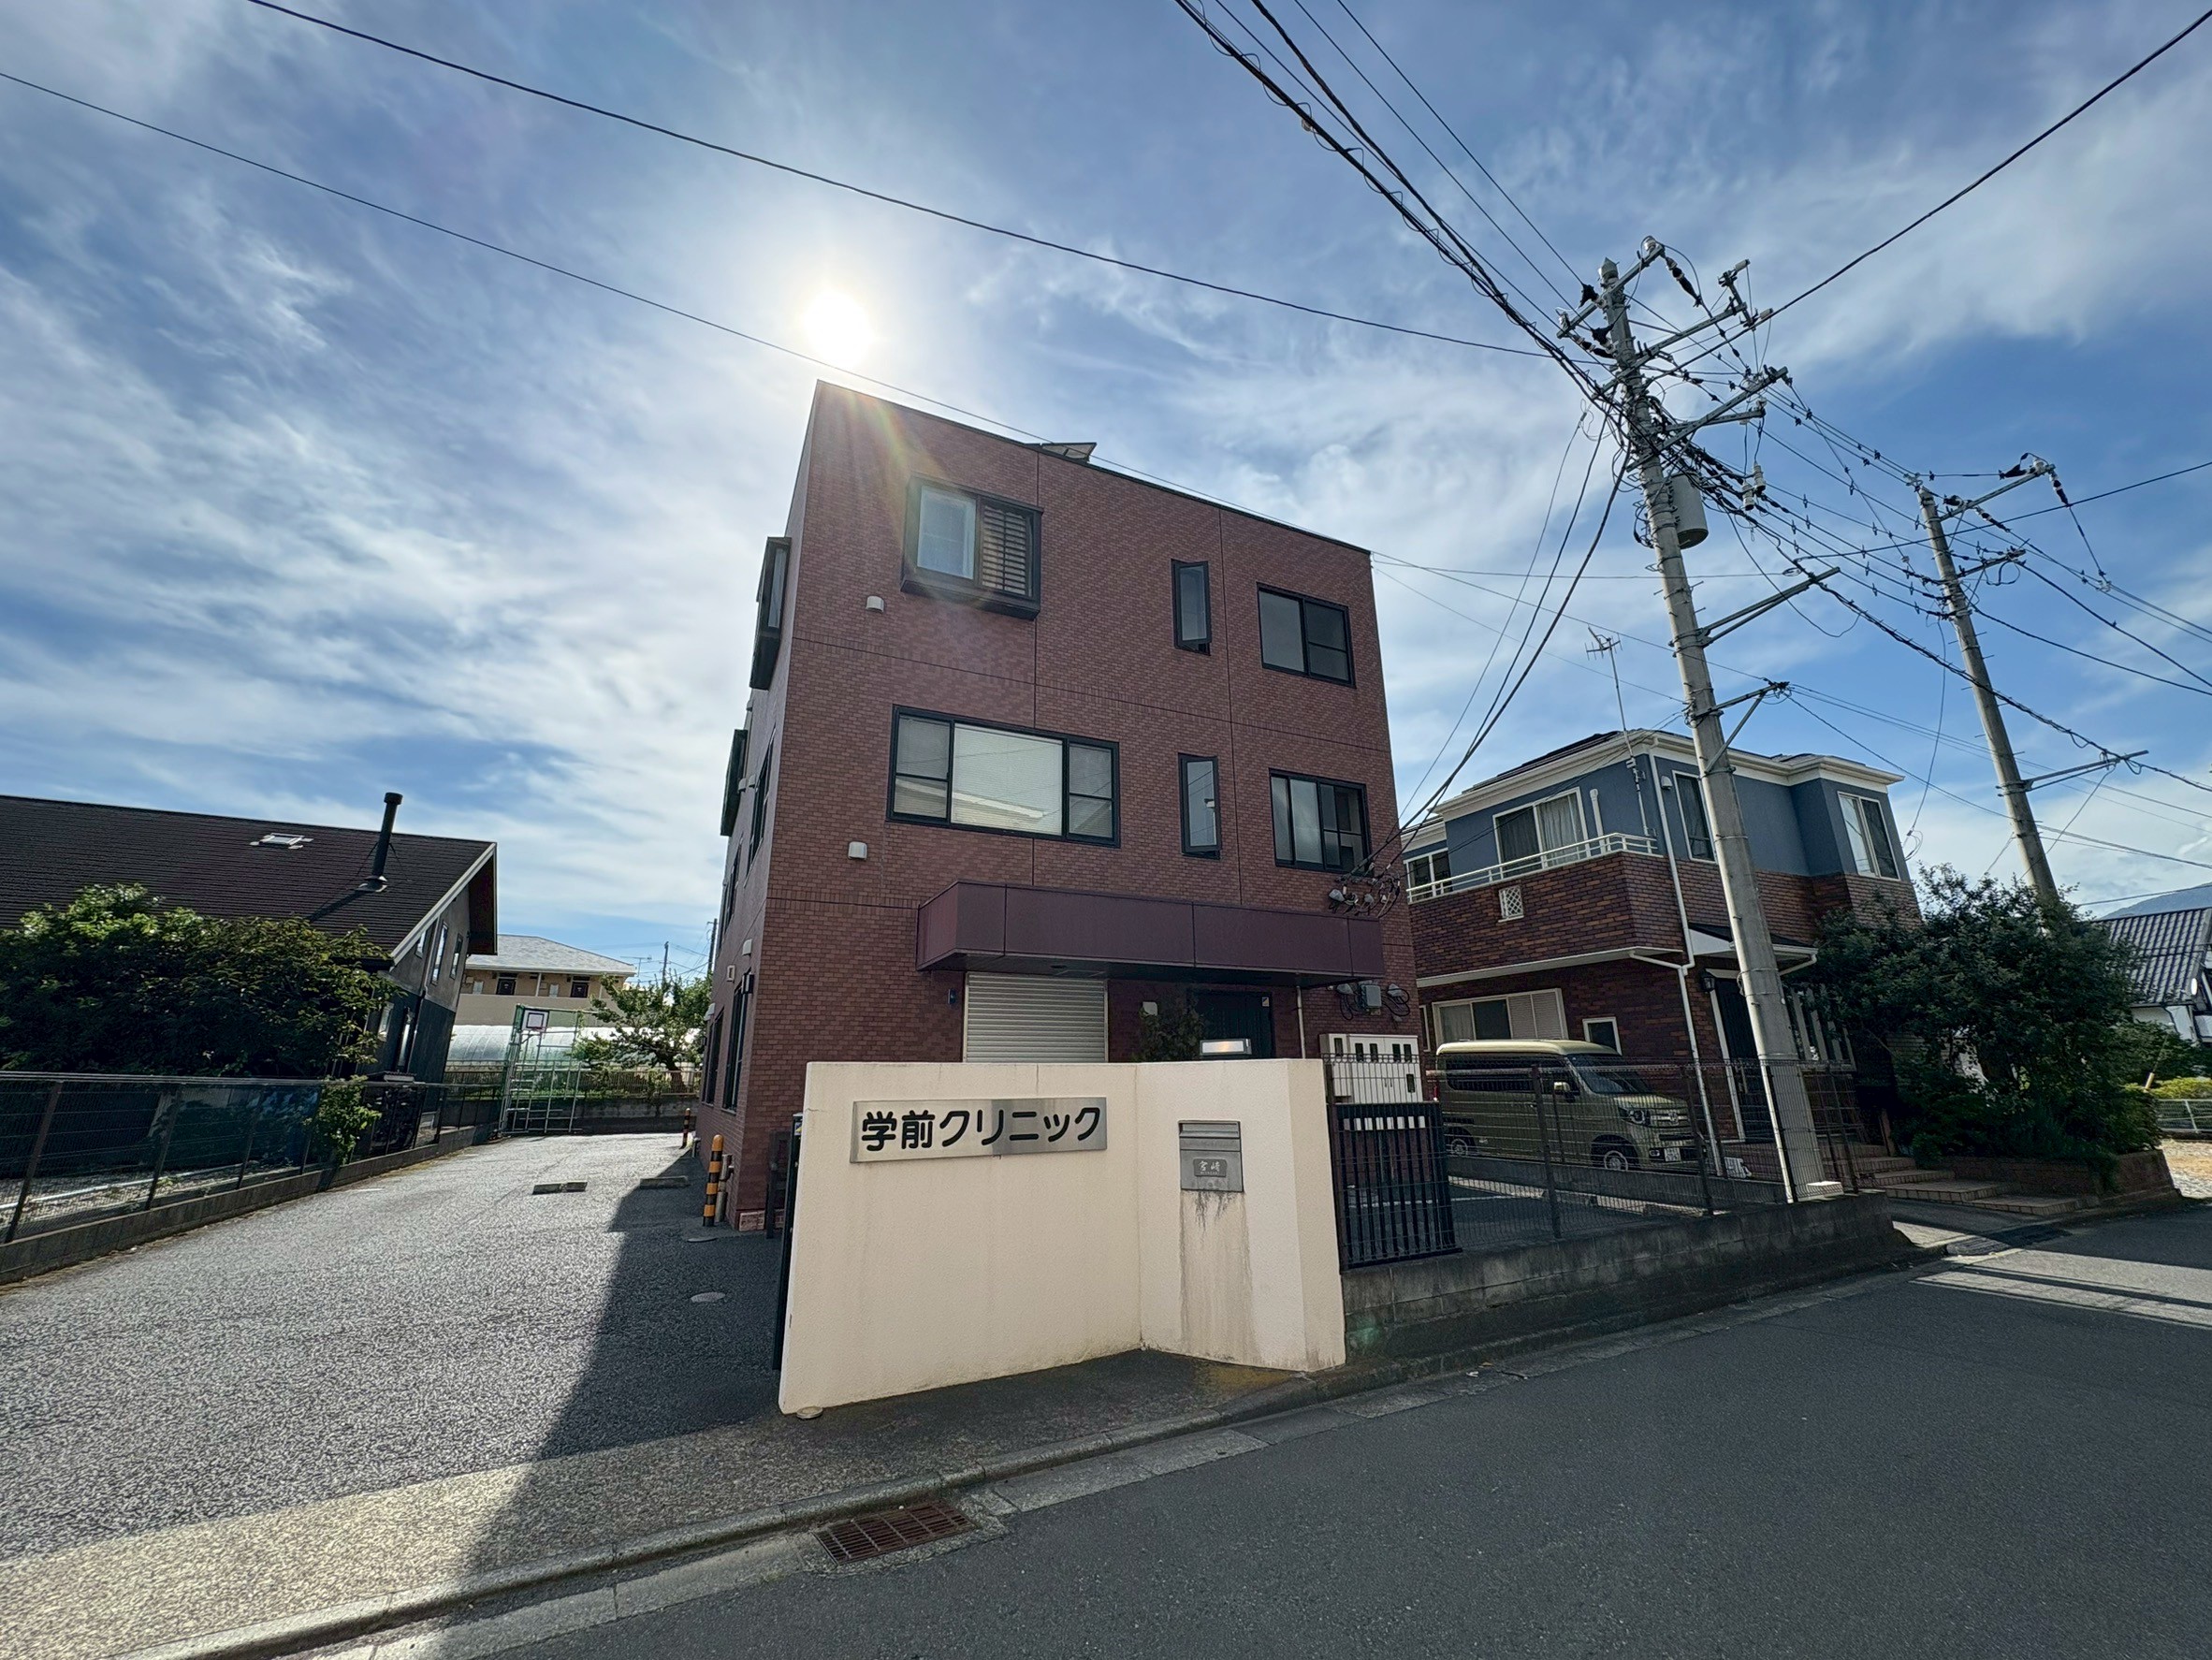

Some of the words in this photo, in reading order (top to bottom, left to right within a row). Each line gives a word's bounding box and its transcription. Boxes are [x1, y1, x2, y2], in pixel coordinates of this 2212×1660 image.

[862, 1107, 1100, 1151] 学前クリニック
